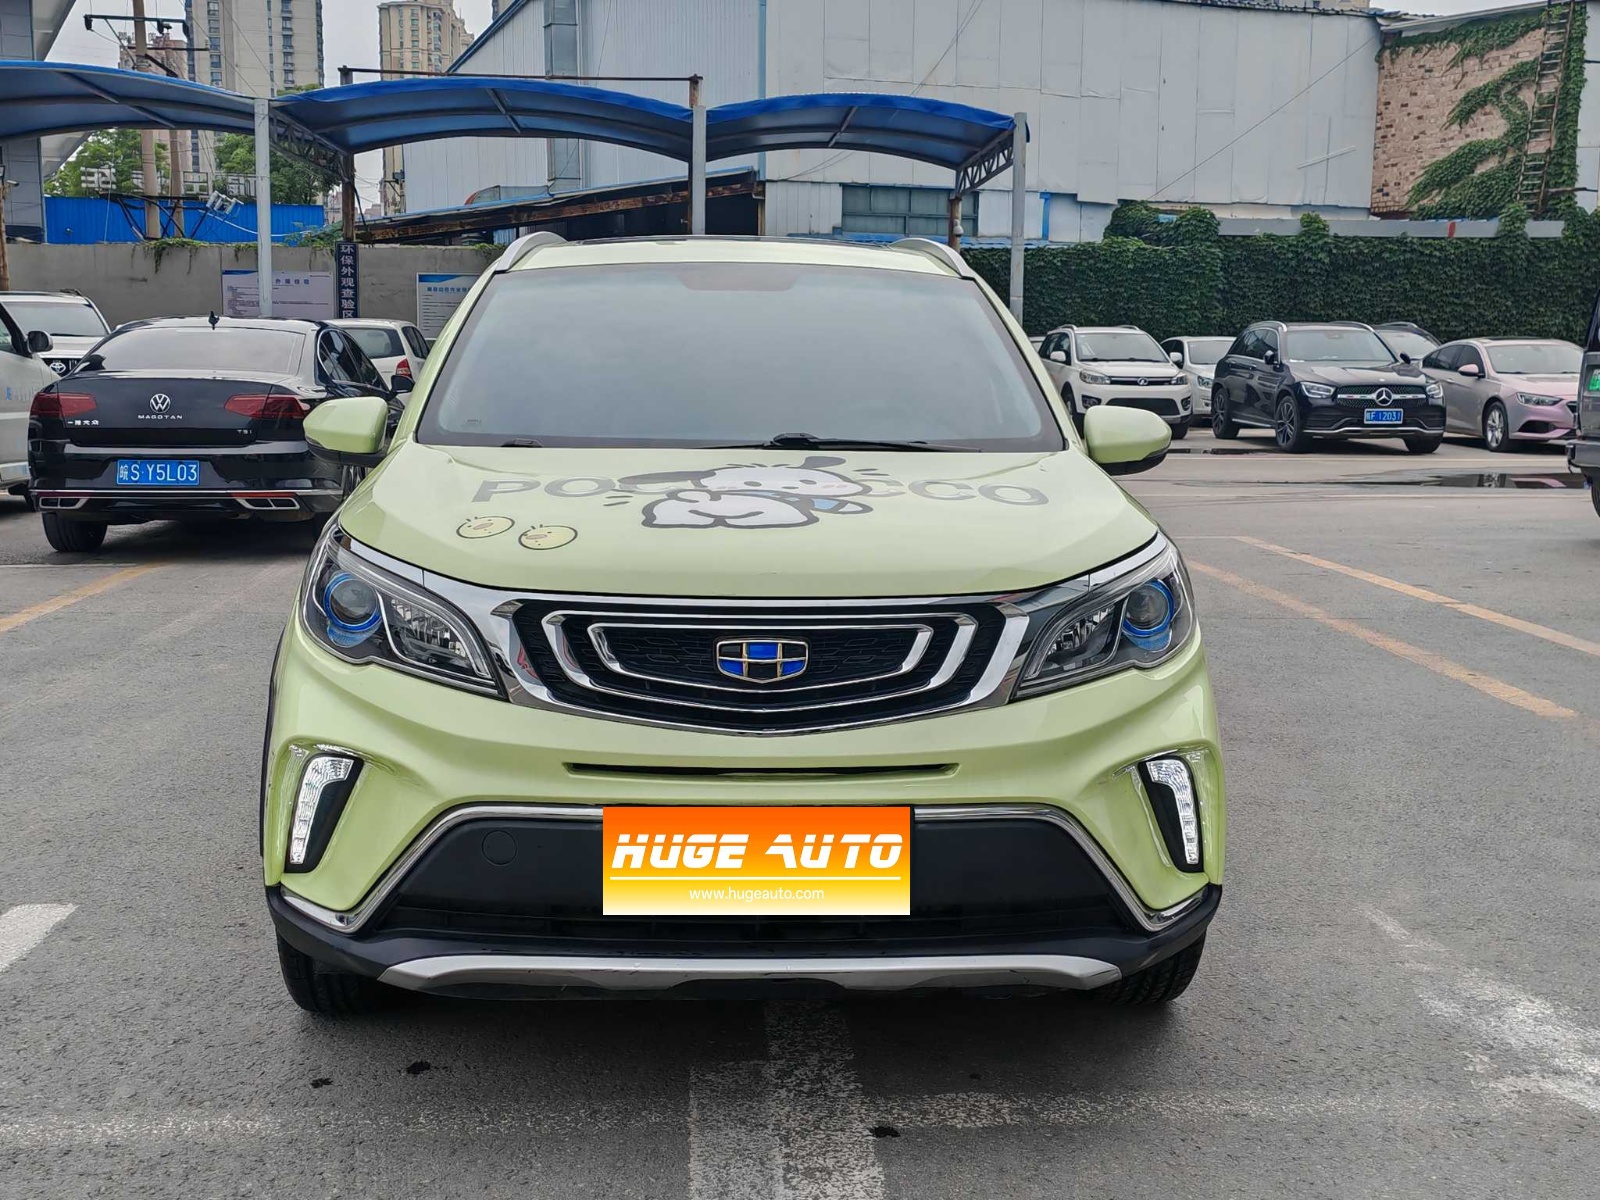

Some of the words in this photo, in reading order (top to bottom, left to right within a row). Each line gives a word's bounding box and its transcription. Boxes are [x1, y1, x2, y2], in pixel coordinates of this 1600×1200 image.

[340, 244, 356, 318] 环保外观查验区
